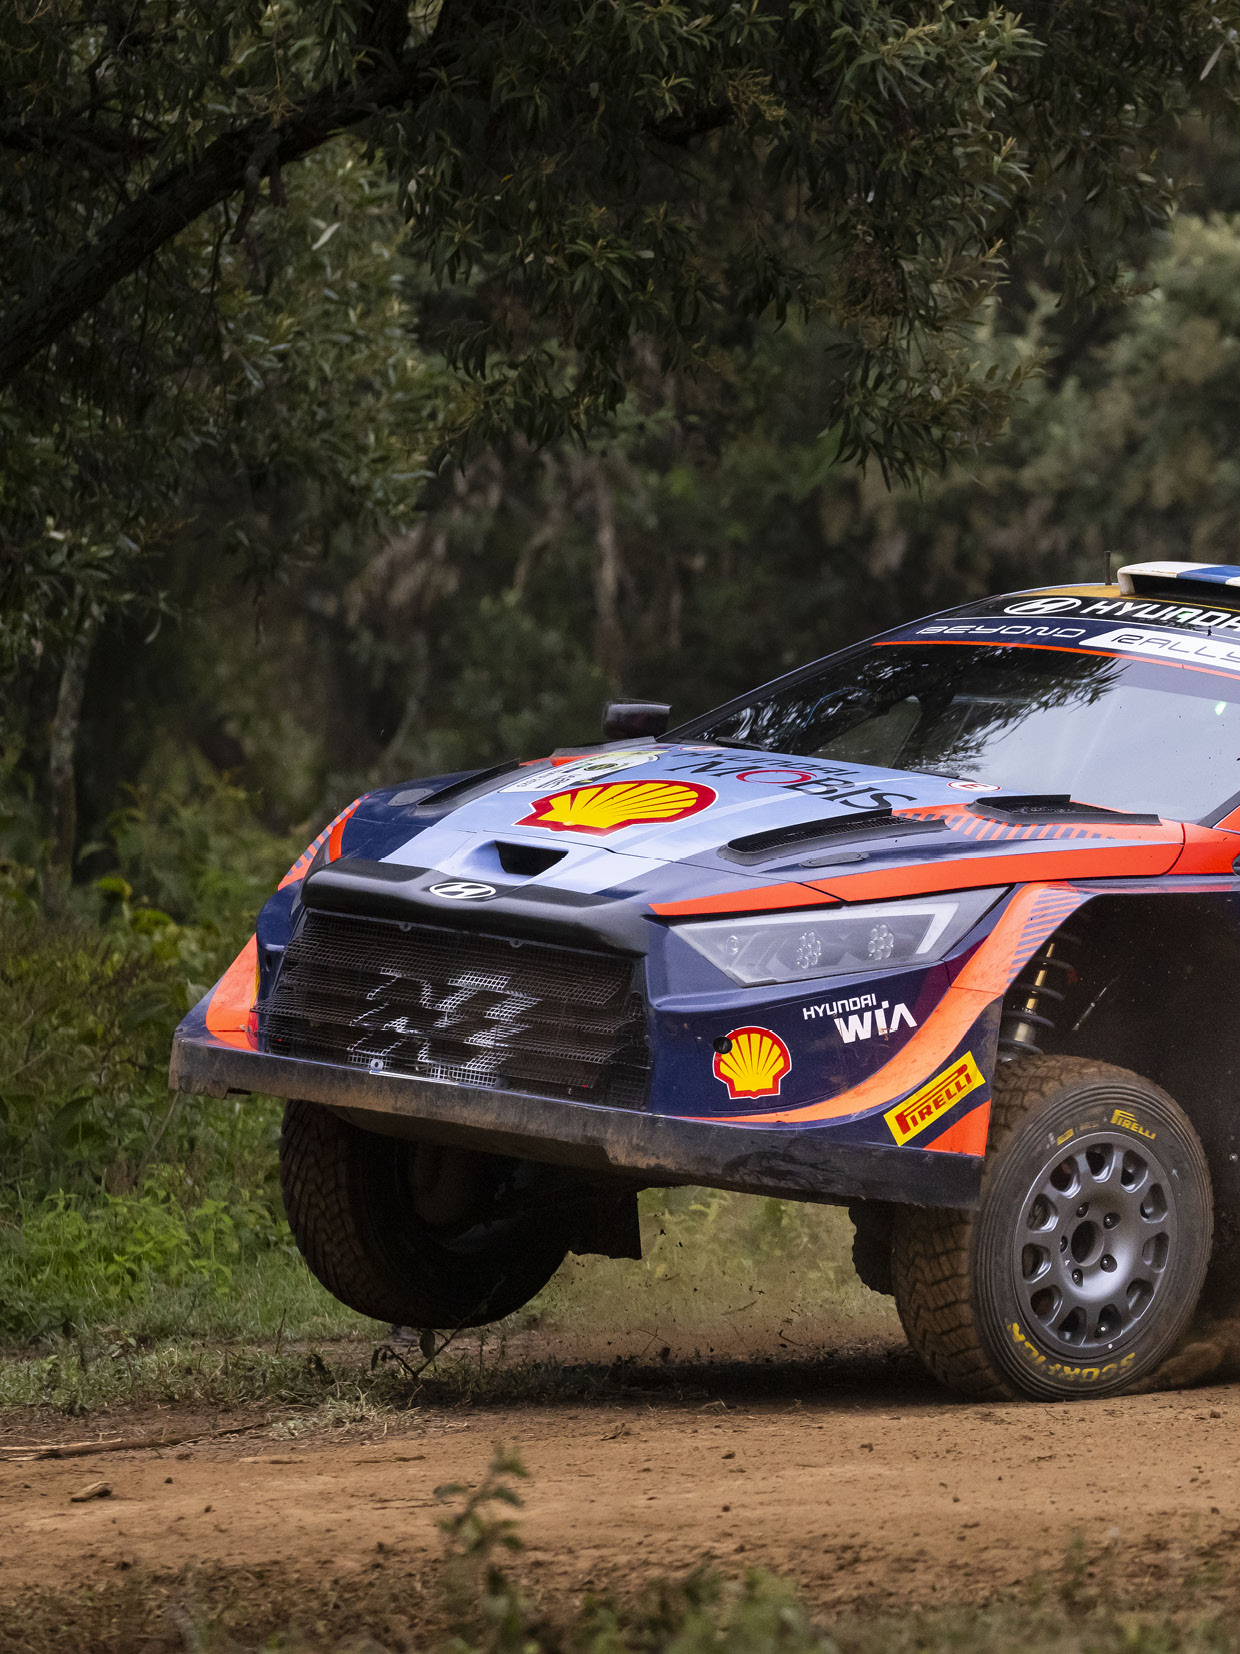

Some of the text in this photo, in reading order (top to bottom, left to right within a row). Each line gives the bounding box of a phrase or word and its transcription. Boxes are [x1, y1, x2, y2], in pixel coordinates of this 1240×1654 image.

[916, 625, 1087, 638] BEYOND
[664, 760, 917, 809] MOBIS
[803, 993, 877, 1020] HYUNDAI
[894, 1063, 972, 1136] PIRELLI
[1110, 1109, 1156, 1140] PIRELLI
